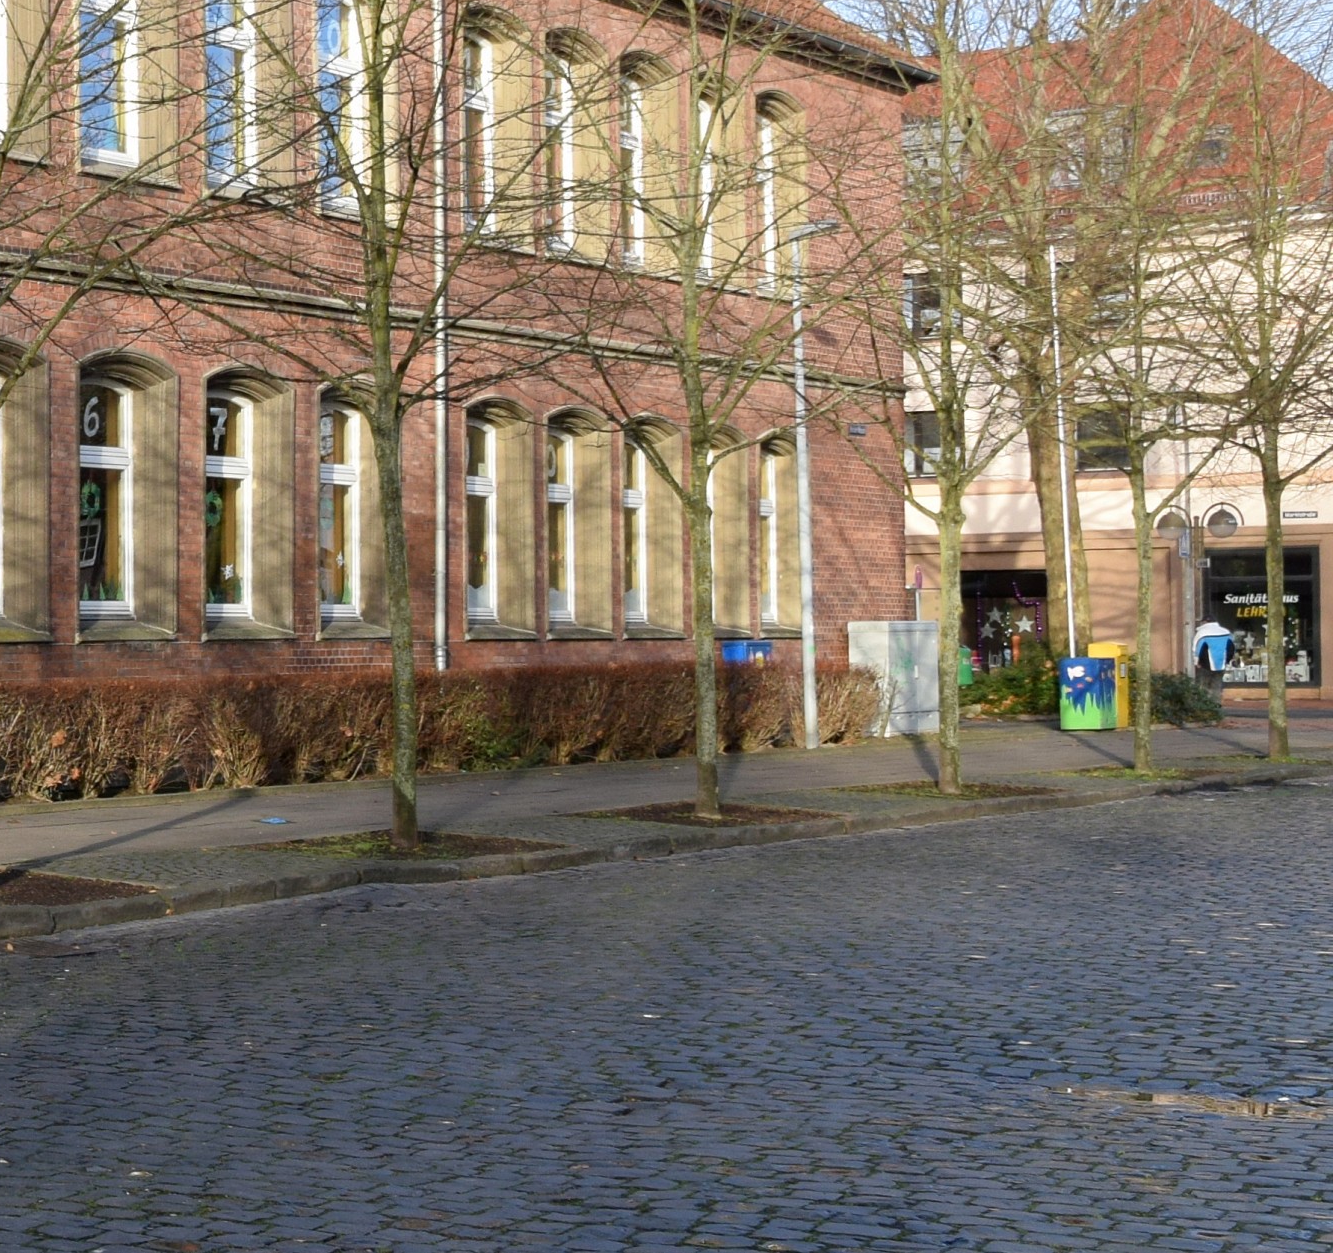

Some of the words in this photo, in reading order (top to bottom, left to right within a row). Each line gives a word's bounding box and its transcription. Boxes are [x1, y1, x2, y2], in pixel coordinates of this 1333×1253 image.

[83, 396, 100, 438] 6
[209, 407, 228, 451] 7
[1223, 593, 1300, 606] Sanitätus
